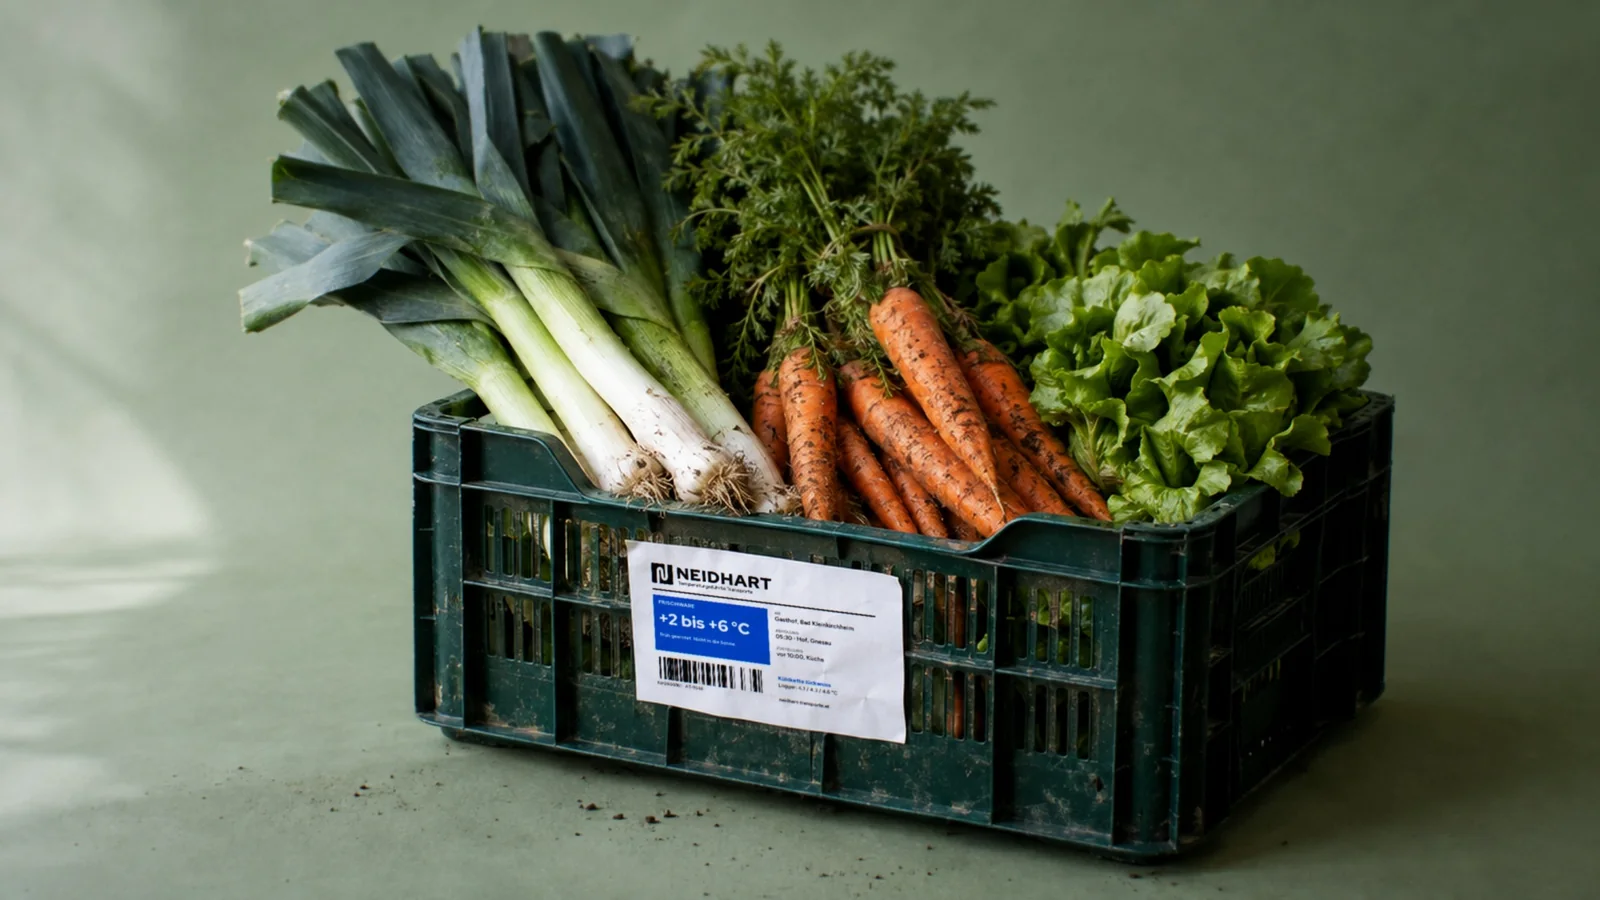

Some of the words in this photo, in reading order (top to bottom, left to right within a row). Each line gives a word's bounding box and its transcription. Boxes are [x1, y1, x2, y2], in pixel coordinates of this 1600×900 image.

[677, 567, 771, 590] NEIDHART
[658, 600, 695, 609] FRISCHWARE
[659, 613, 678, 626] +2
[681, 615, 705, 629] bis
[709, 620, 728, 632] +6
[731, 621, 750, 635] °C
[775, 616, 799, 624] Gasthof,
[806, 655, 825, 663] Küche
